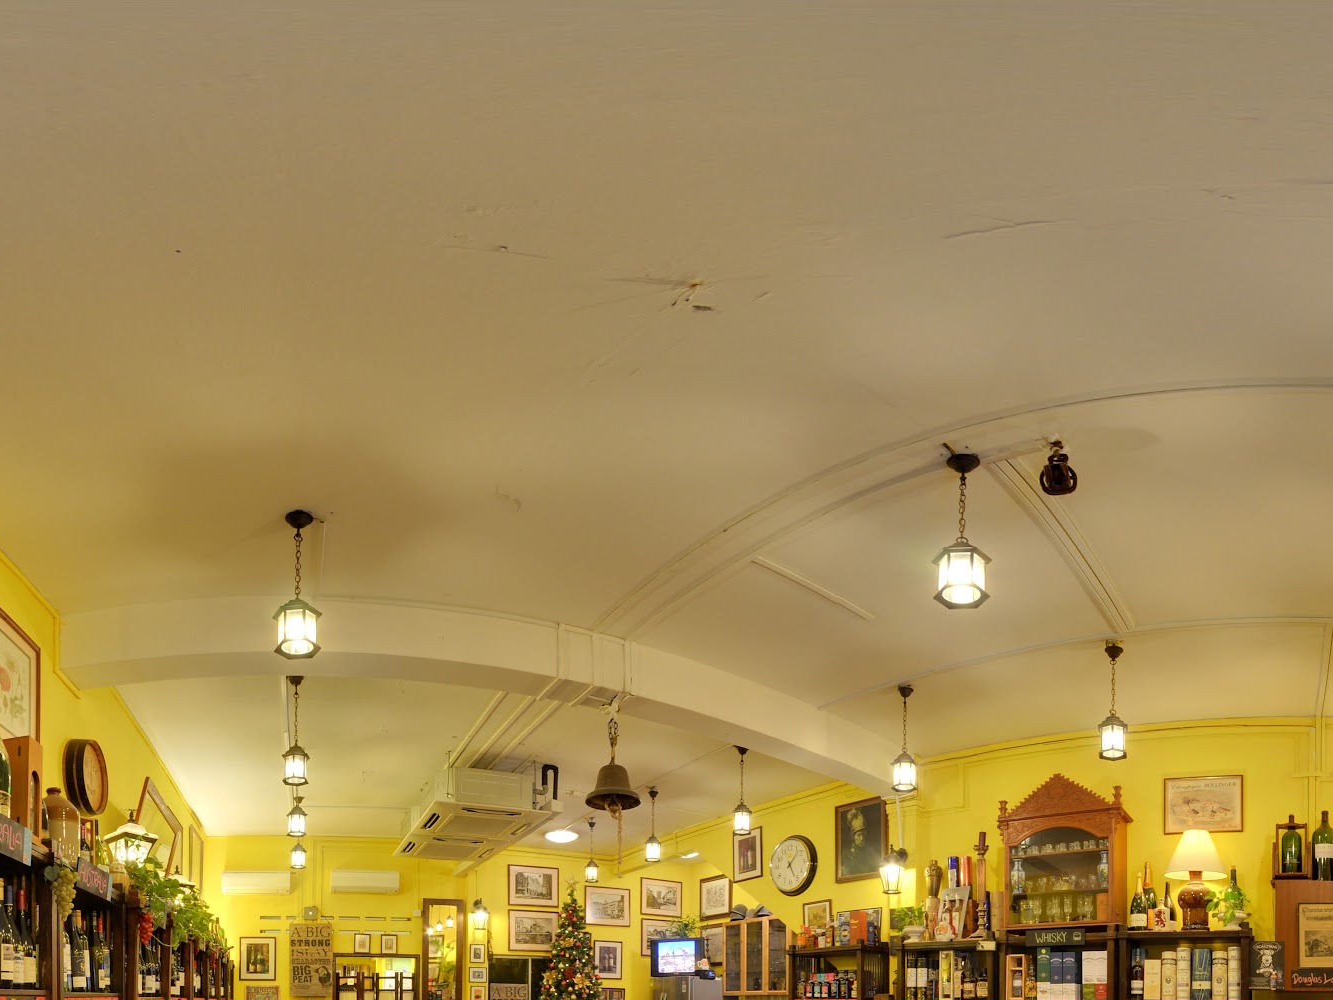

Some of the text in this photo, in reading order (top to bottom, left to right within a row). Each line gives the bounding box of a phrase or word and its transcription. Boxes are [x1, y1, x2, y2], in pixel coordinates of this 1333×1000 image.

[1204, 781, 1237, 789] BOLLINGER
[291, 926, 331, 938] A BIG
[1035, 931, 1068, 944] WHISKY
[290, 939, 331, 947] STRONG
[292, 965, 312, 976] BIG
[292, 975, 313, 984] PEAT
[1292, 973, 1322, 986] Douglas
[507, 987, 527, 998] BIG
